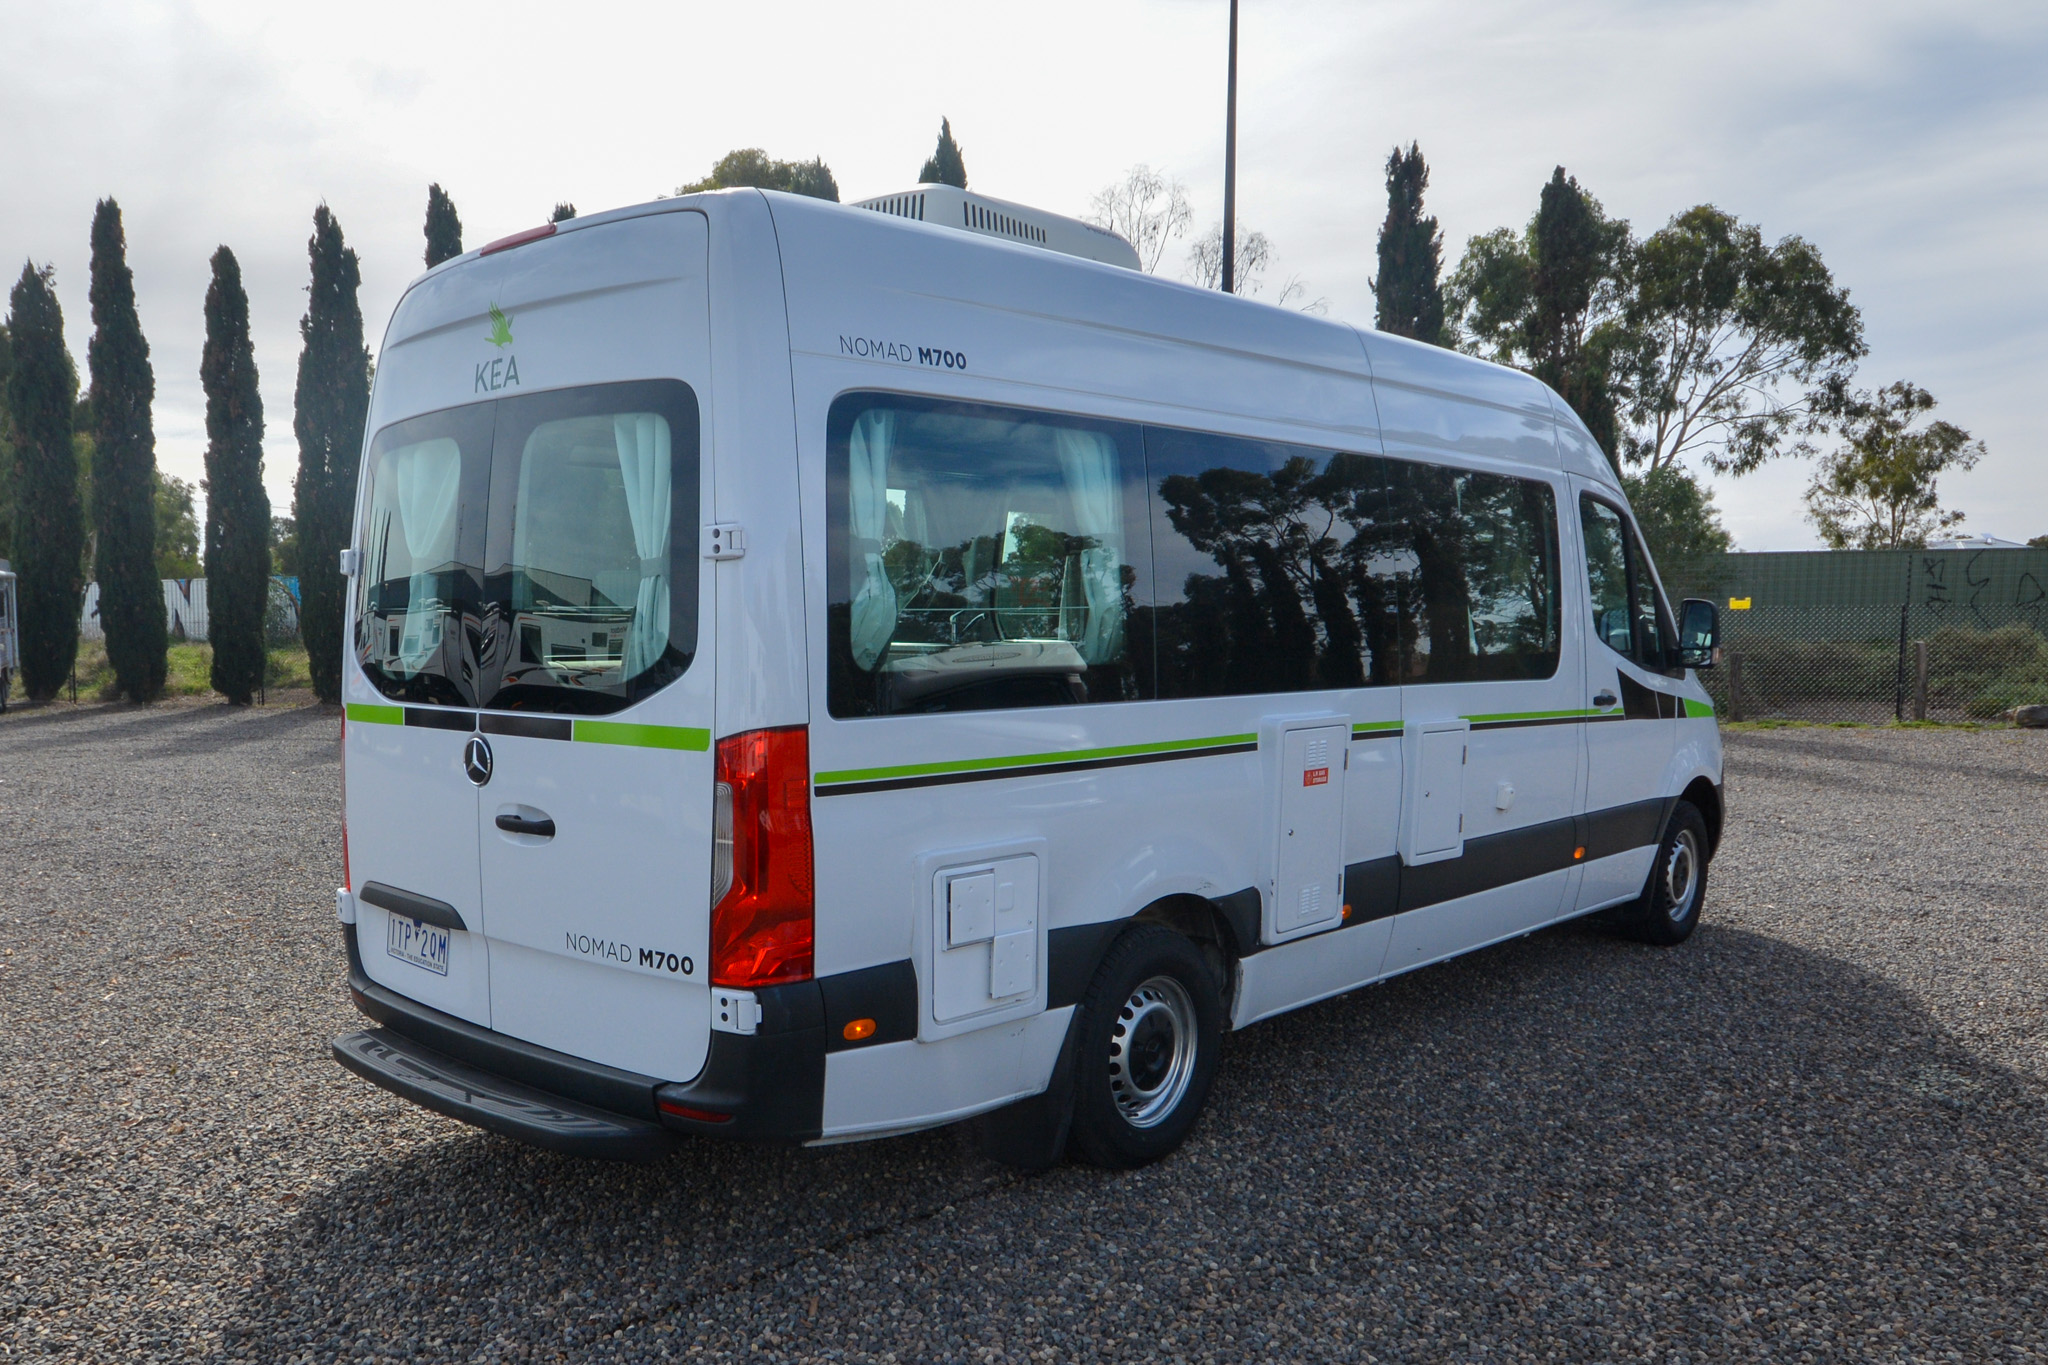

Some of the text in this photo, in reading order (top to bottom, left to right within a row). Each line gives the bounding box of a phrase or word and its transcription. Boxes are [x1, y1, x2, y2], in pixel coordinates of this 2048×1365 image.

[839, 335, 967, 370] NOMAD M700
[474, 355, 520, 393] KEA
[566, 931, 694, 975] NOMAD M700
